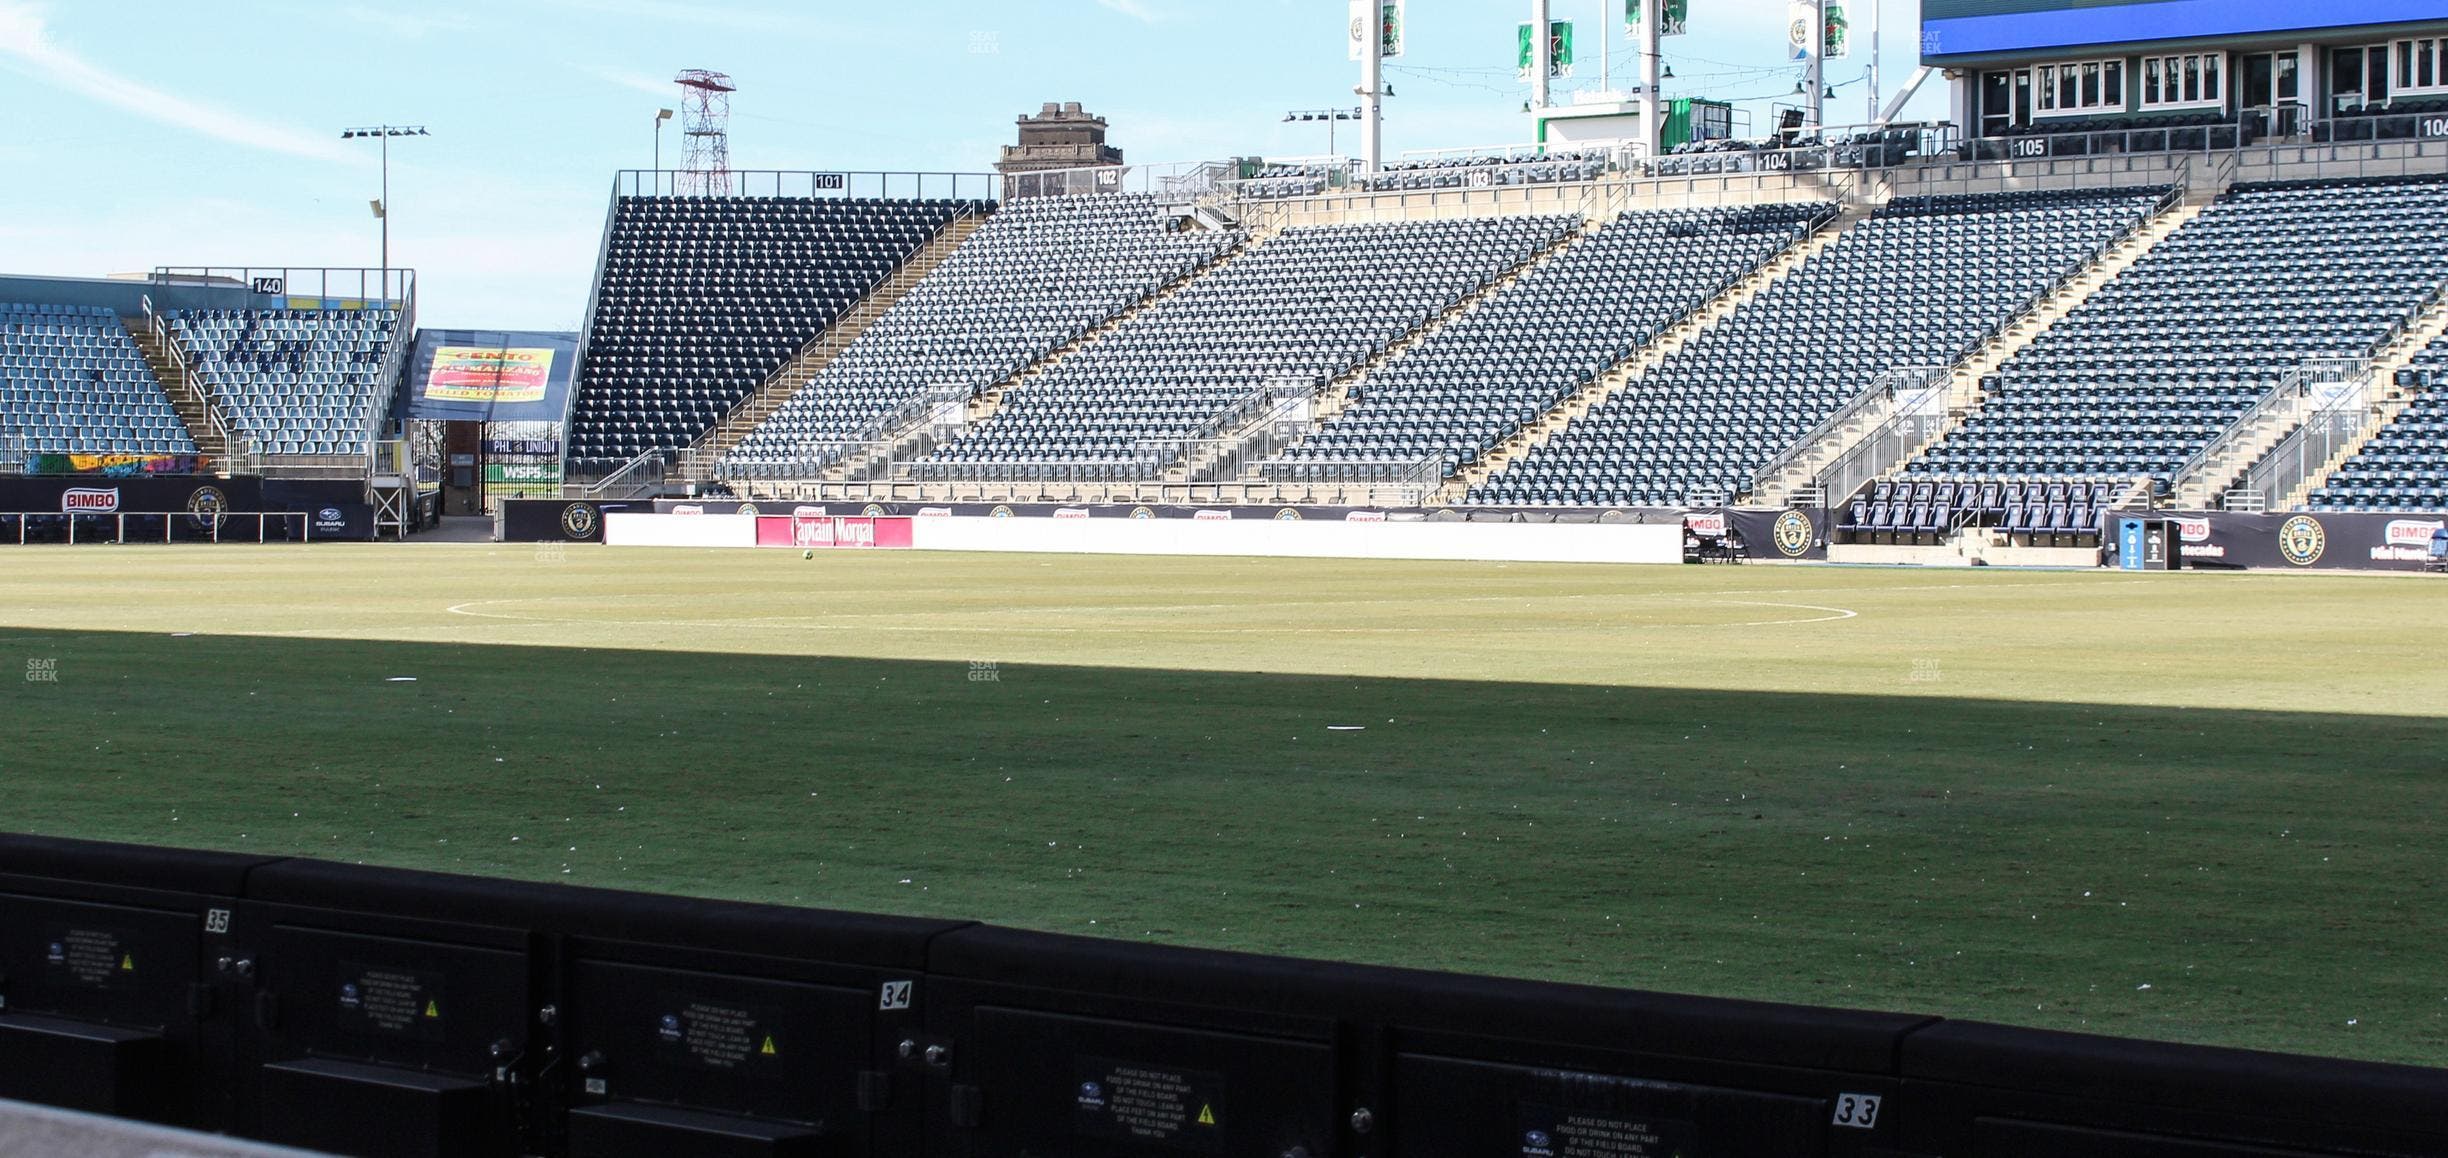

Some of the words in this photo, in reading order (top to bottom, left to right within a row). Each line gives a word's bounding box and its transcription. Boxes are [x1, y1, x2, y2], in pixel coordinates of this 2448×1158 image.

[2018, 139, 2044, 156] 105
[1764, 153, 1787, 170] 104
[818, 176, 840, 188] 101
[1098, 170, 1117, 184] 102
[1467, 172, 1488, 187] 103
[256, 279, 281, 293] 140
[456, 352, 534, 361] CENTO
[494, 440, 512, 453] PHL
[66, 494, 114, 507] BIMBO
[208, 911, 227, 930] 35
[882, 983, 909, 1006] 34
[1838, 1097, 1876, 1125] 33
[1568, 1116, 1594, 1126] PLEASE
[1624, 1122, 1646, 1132] PLACE
[1556, 1124, 1576, 1134] FOOD
[1589, 1129, 1610, 1137] DRINK
[1612, 1131, 1623, 1139] ON
[1624, 1133, 1639, 1141] ANY
[1640, 1135, 1658, 1144] PART
[1569, 1136, 1578, 1145] OF
[1581, 1138, 1594, 1147] THE
[1596, 1139, 1616, 1150] FIELD
[1522, 1146, 1554, 1156] SUBARU
[1564, 1146, 1575, 1155] DO
